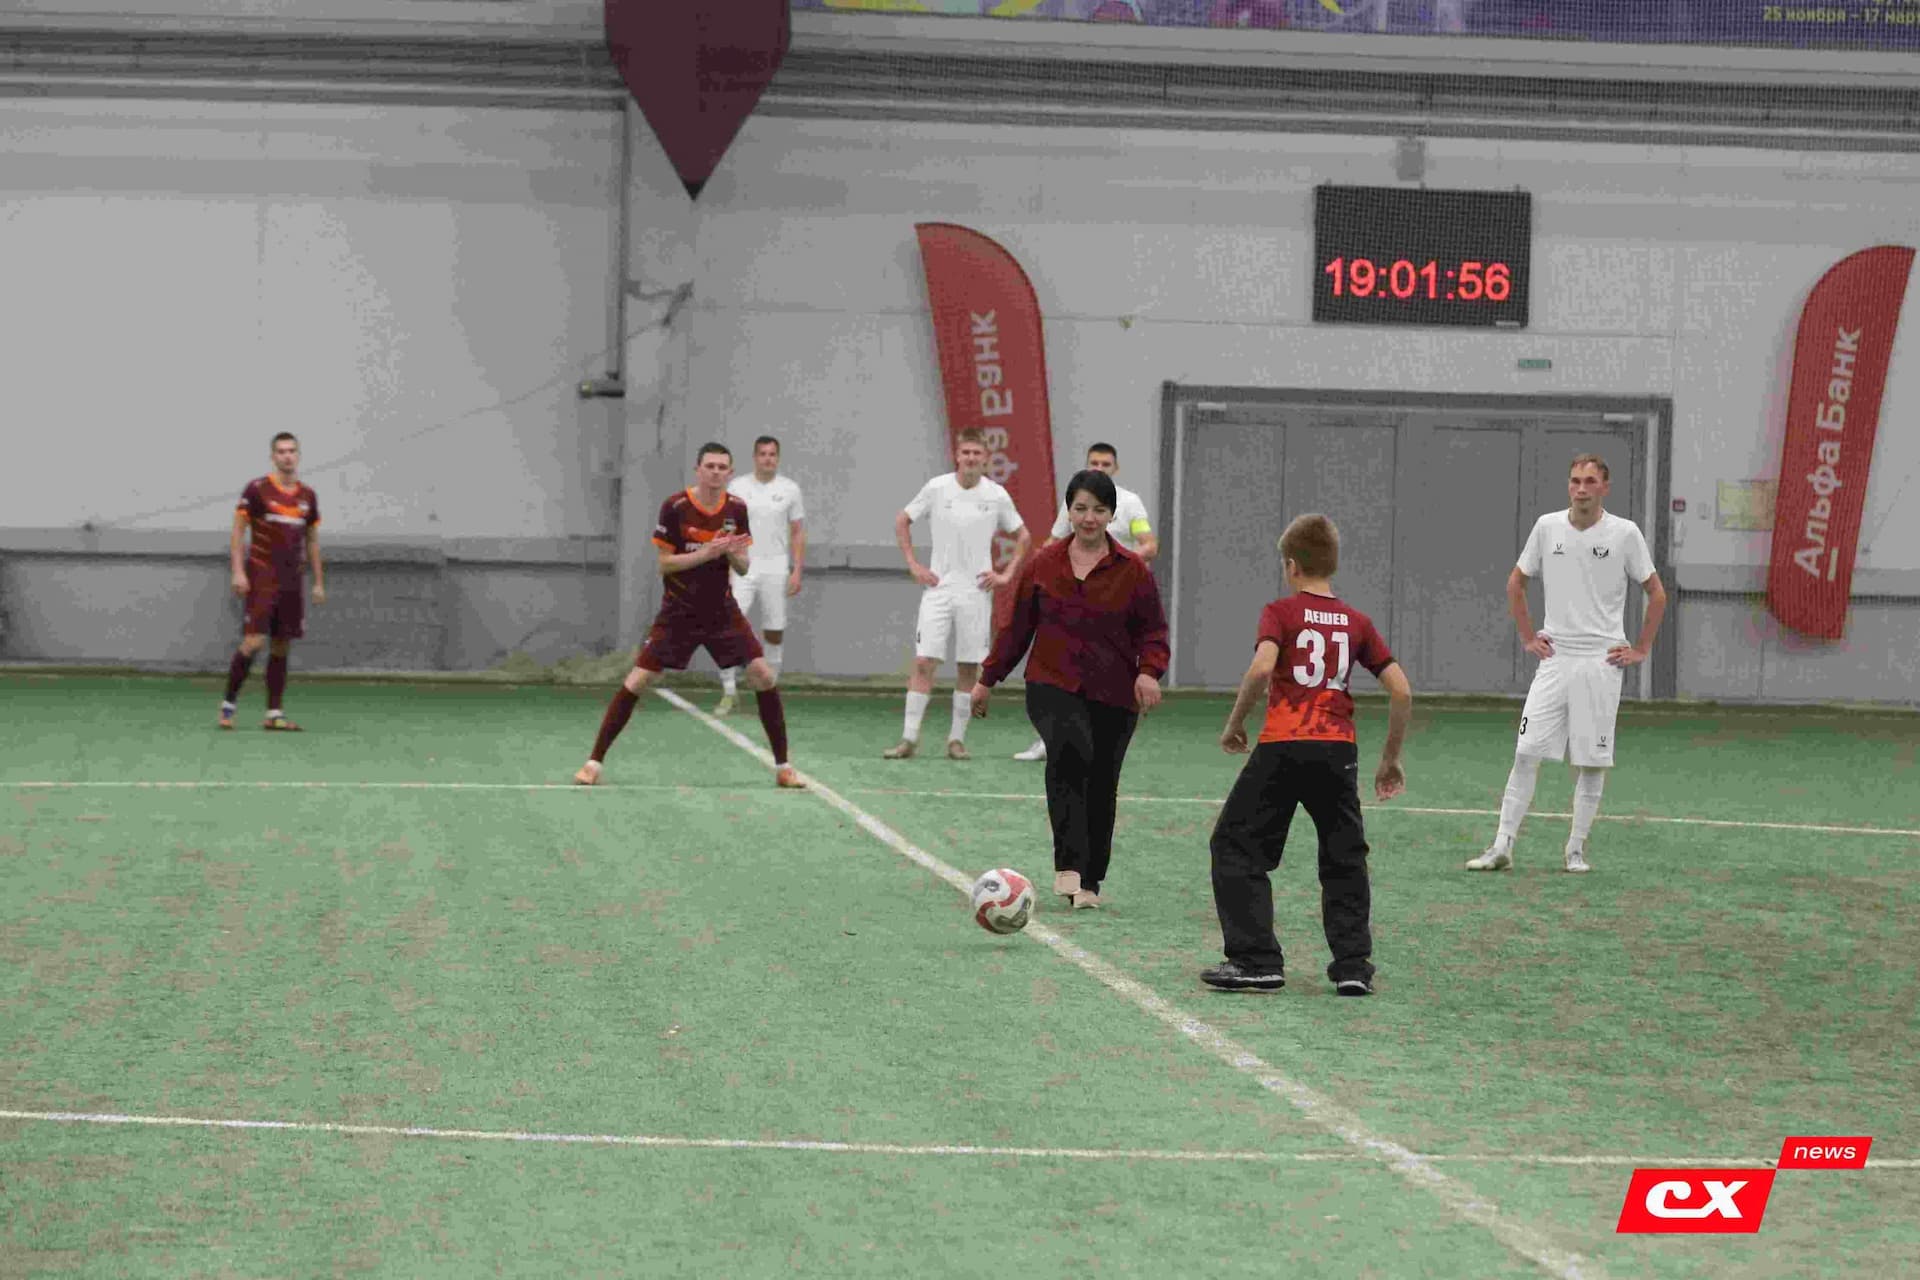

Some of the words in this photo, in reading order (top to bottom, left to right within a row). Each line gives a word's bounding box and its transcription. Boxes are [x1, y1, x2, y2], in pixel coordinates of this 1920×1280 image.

[1325, 257, 1511, 301] 19:01:56
[1816, 326, 1861, 432] Банк
[1794, 441, 1843, 578] Альфа
[1303, 608, 1349, 626] ДЕШЕВ
[1293, 628, 1350, 691] 31
